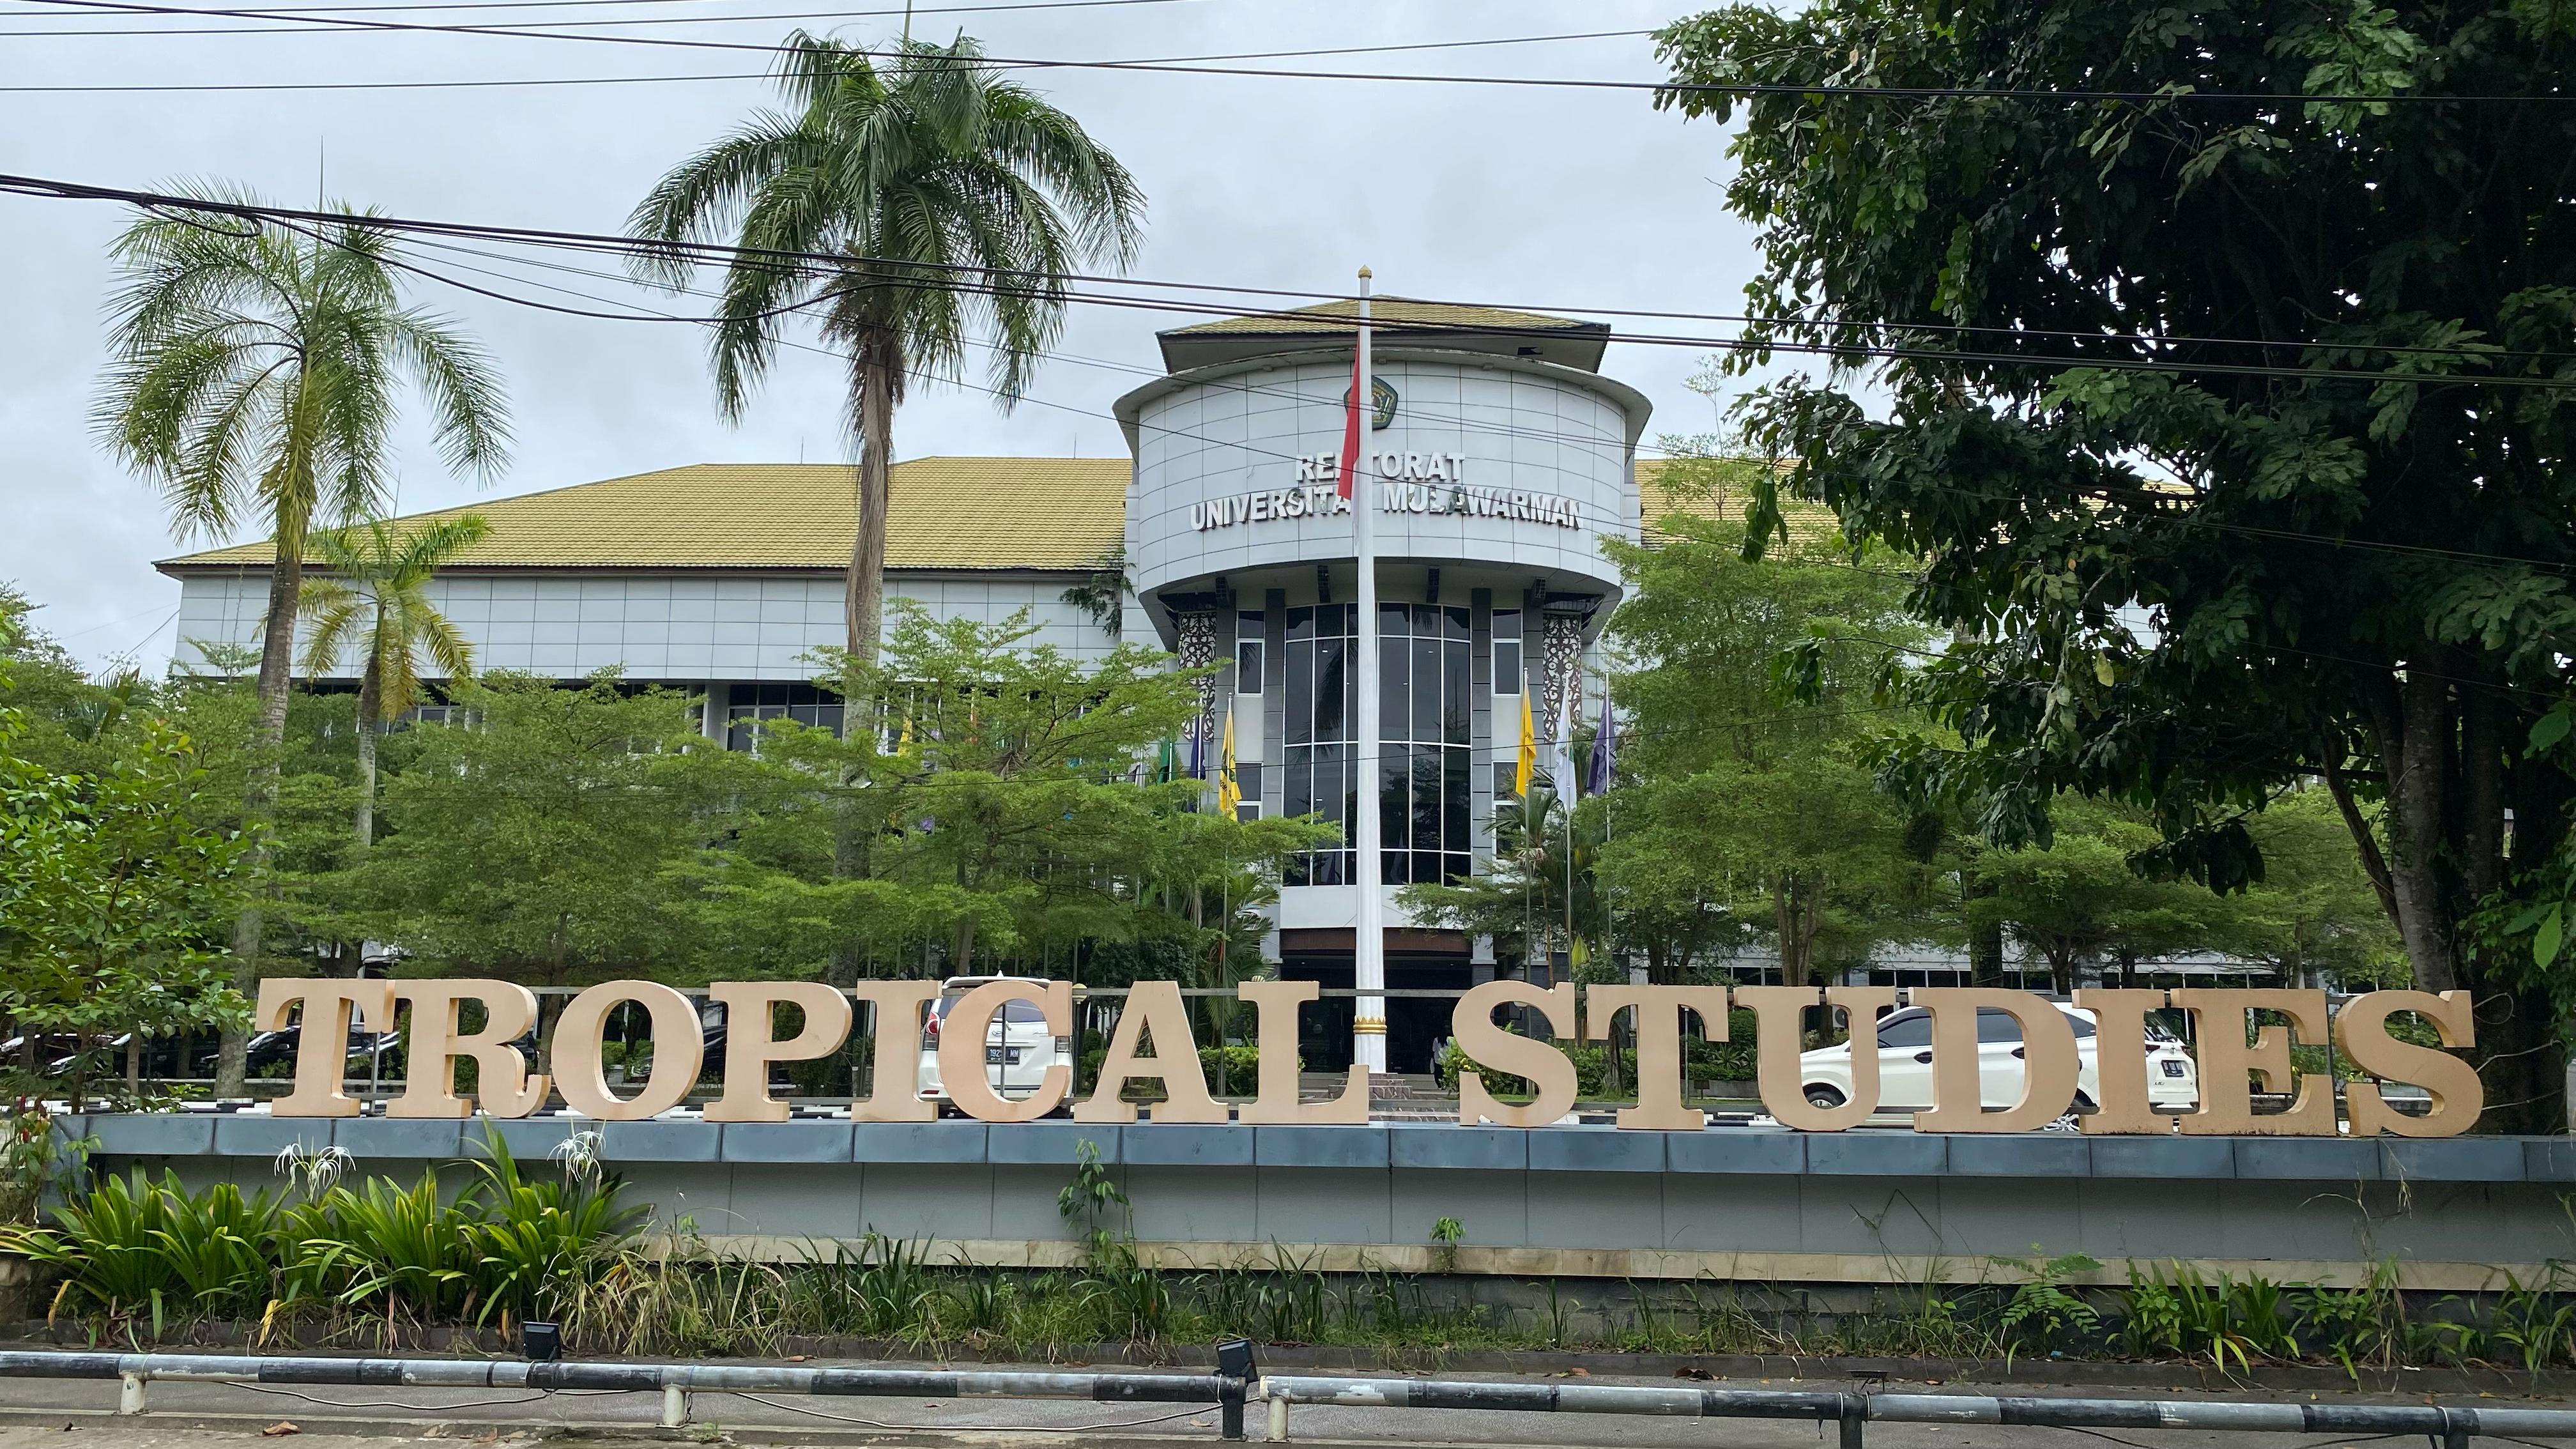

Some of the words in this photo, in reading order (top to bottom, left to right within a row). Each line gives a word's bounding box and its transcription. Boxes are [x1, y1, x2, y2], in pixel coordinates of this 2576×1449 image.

[1296, 450, 1465, 480] REORAT
[1190, 486, 1351, 531] UNIVERSITA
[1383, 482, 1583, 530] MULAWARMAN
[256, 978, 1369, 1122] TROPICAL
[1452, 980, 2484, 1137] STUDIES
